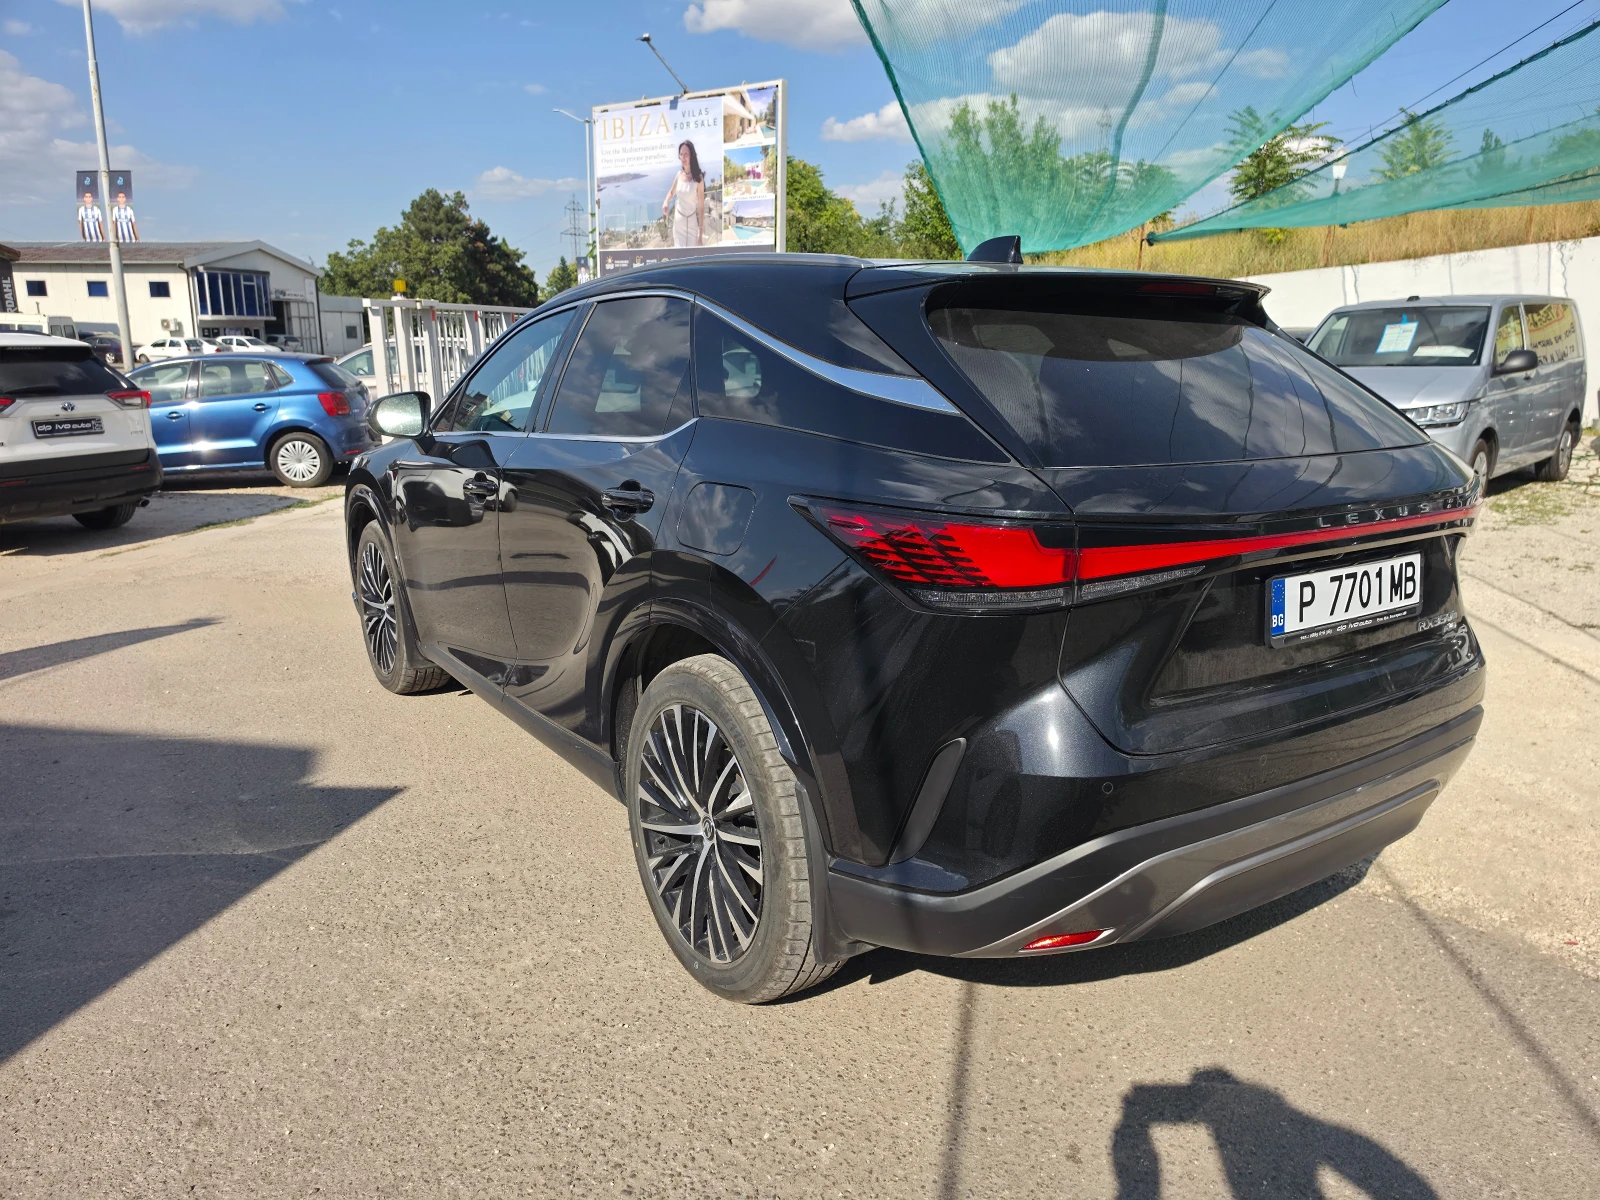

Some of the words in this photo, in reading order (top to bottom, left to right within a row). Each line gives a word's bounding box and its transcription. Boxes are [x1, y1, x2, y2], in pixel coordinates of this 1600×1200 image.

[681, 107, 709, 118] VILAS
[602, 112, 671, 141] IBIZA
[673, 121, 691, 131] FOR
[694, 117, 718, 128] SALE
[1316, 502, 1430, 528] LEXUS
[1299, 580, 1316, 623] P
[1329, 566, 1383, 617] 7701
[1389, 560, 1416, 603] MB
[1272, 614, 1284, 628] BG
